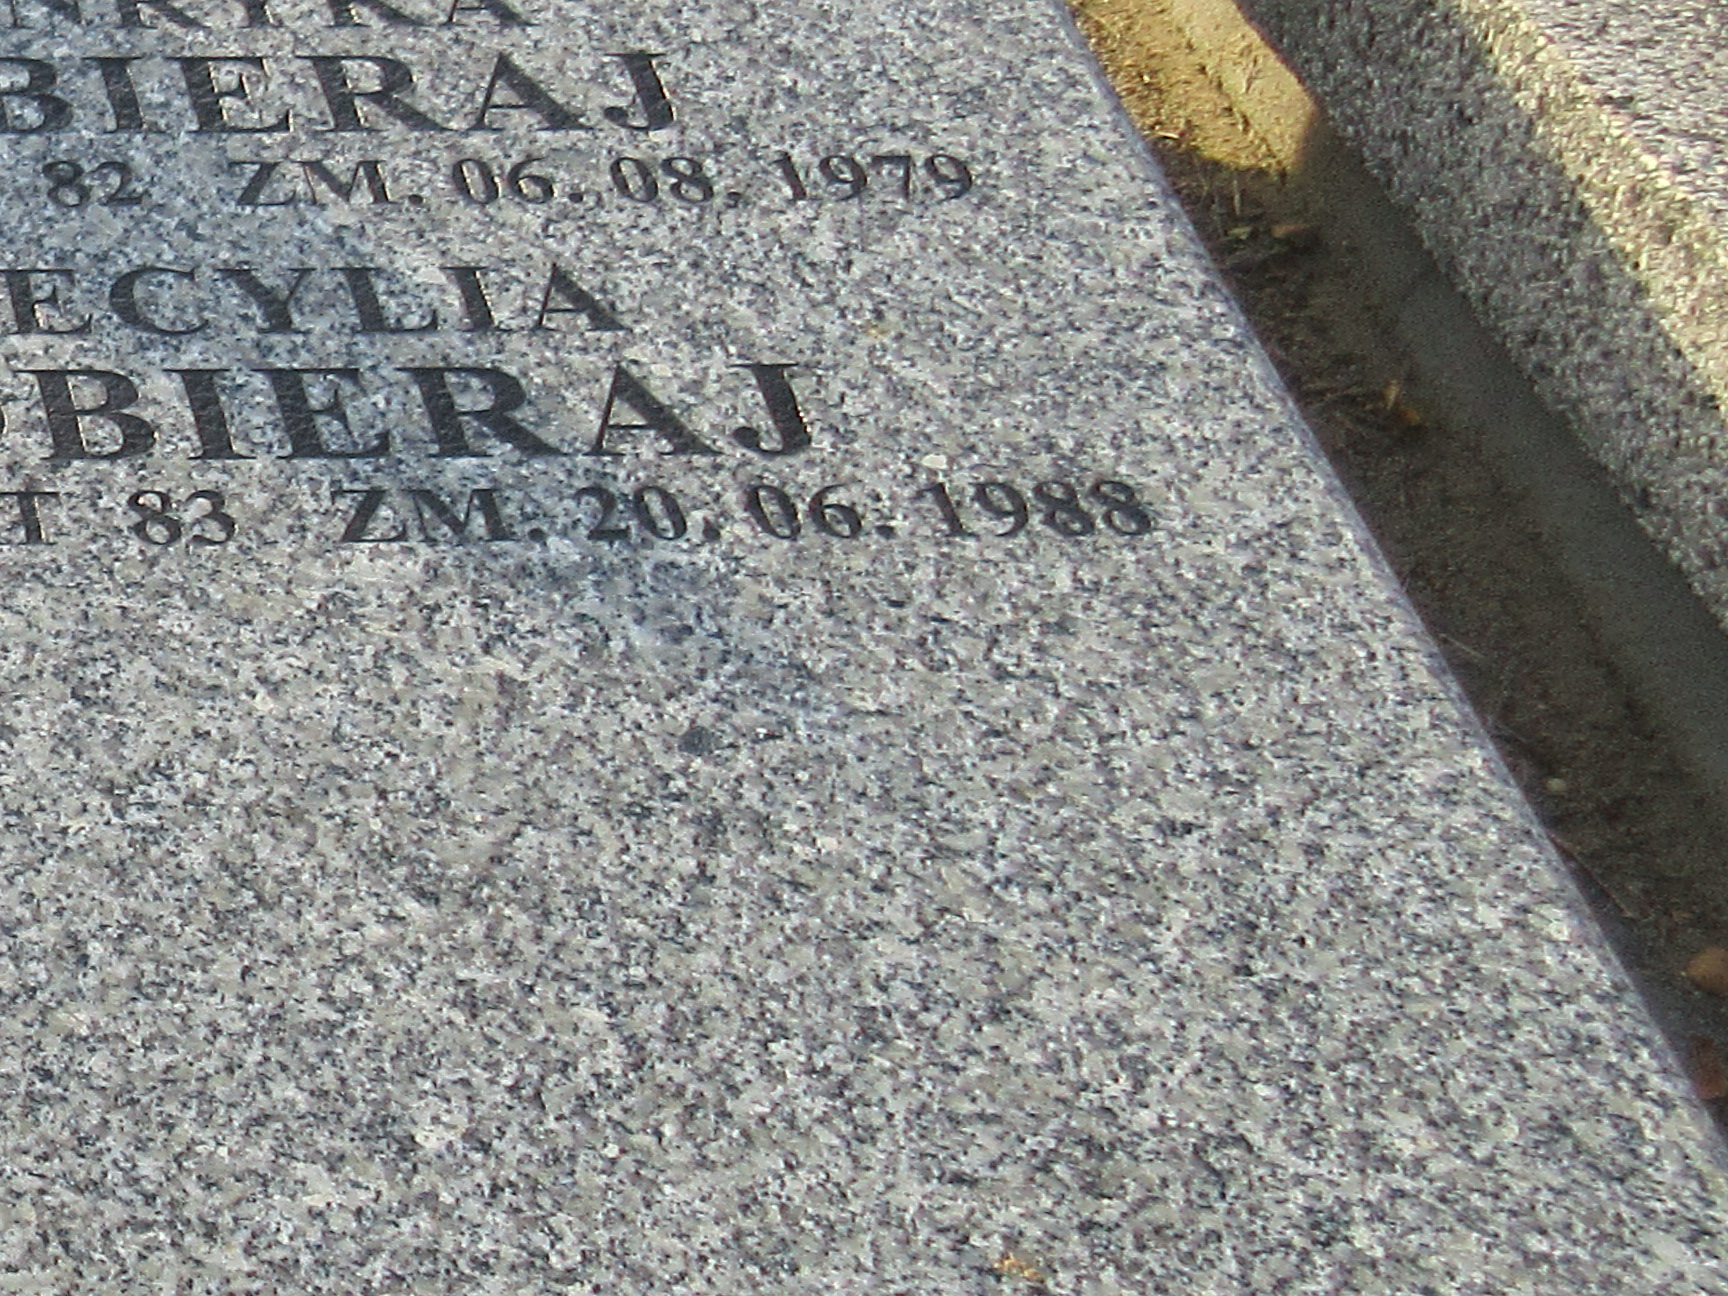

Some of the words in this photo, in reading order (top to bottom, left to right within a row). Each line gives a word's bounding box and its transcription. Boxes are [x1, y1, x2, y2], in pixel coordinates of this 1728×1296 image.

[42, 160, 146, 207] 82
[227, 159, 428, 207] ZM.
[126, 488, 238, 546] 83
[335, 488, 544, 544] ZM.
